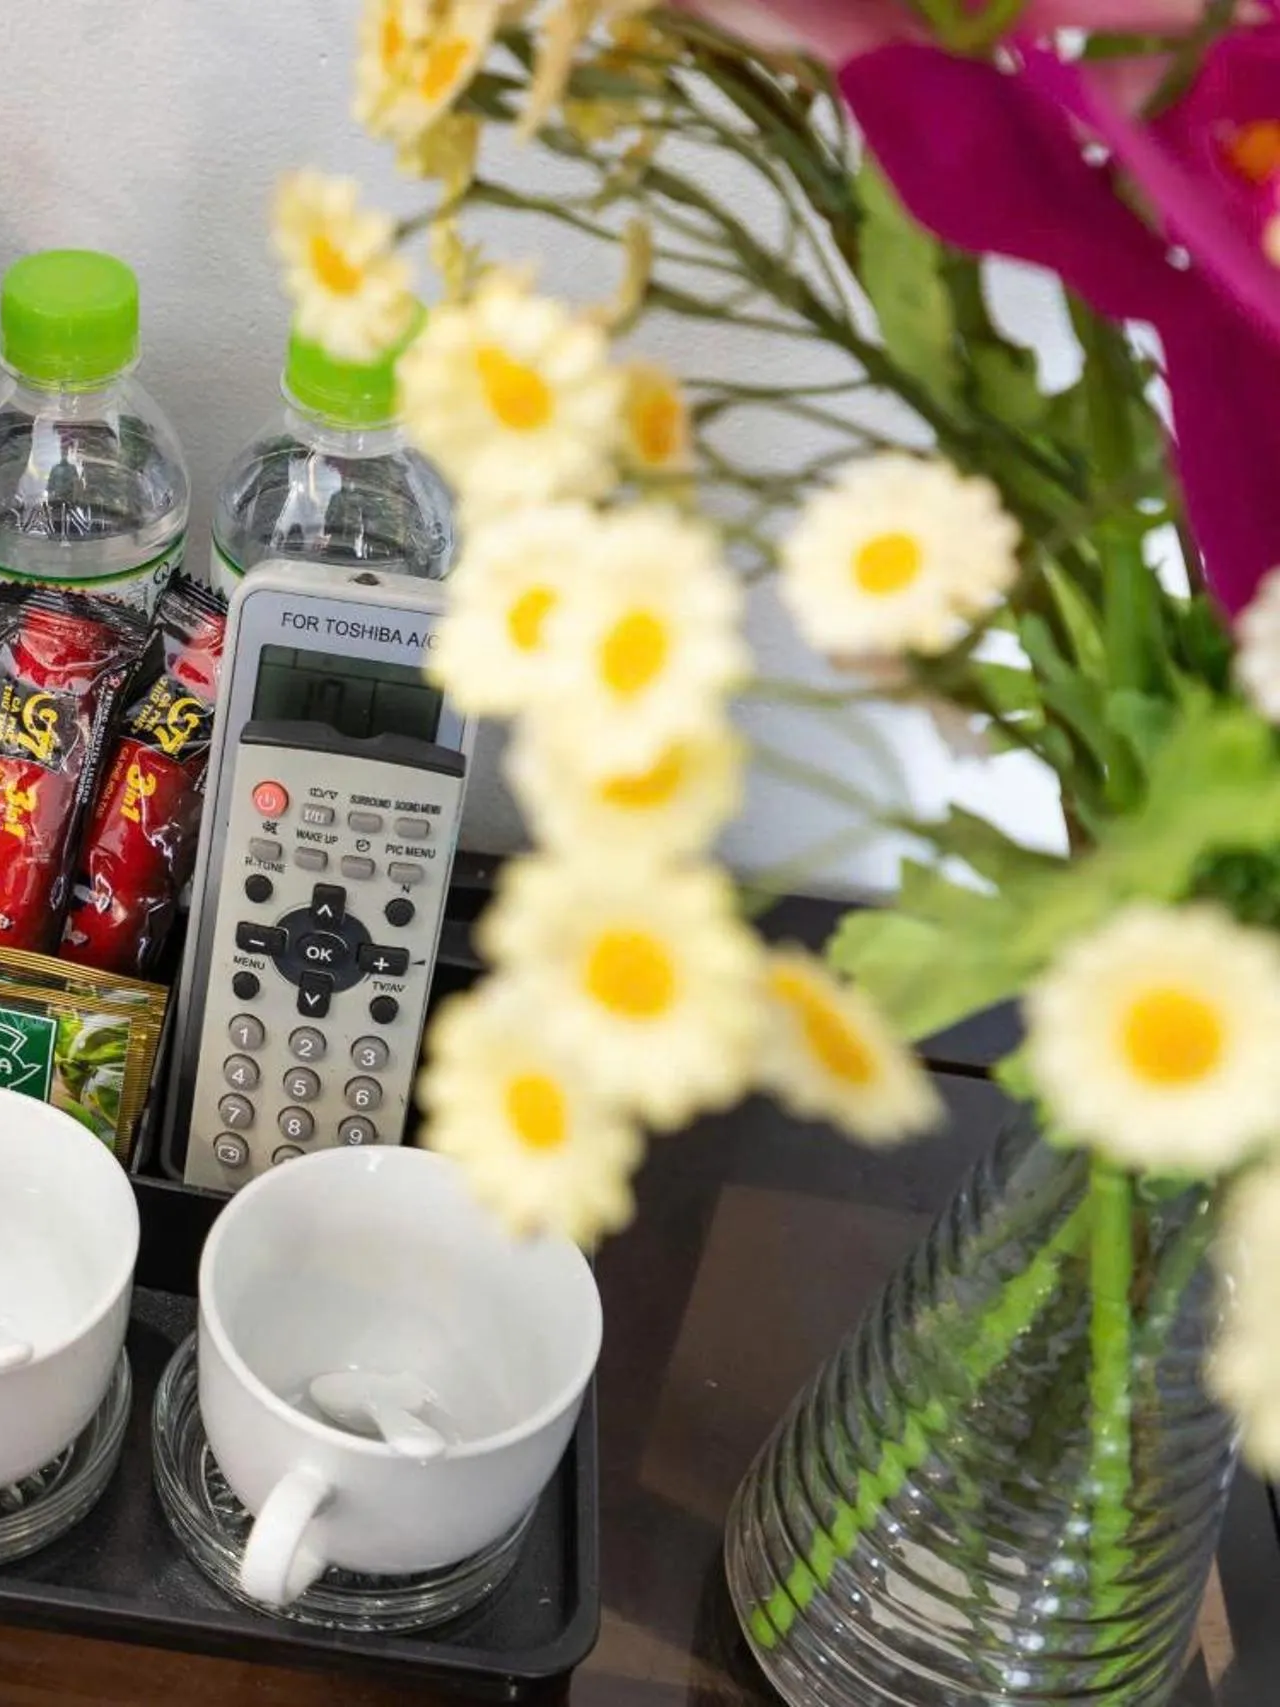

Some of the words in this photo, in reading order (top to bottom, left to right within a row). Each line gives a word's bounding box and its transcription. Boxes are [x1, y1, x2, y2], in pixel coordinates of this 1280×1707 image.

[281, 611, 319, 632] FOR
[326, 618, 403, 645] TOSHIBA
[120, 763, 156, 823] 3in1
[296, 828, 322, 842] WAKE
[324, 835, 338, 845] UP
[385, 843, 403, 856] PIC
[405, 846, 436, 860] MENU
[232, 955, 266, 971] MENU
[306, 946, 333, 963] OK
[372, 980, 407, 994] TV/AV
[239, 1028, 249, 1045] 1
[300, 1039, 313, 1057] 2
[362, 1049, 377, 1067] 3
[232, 1068, 246, 1084] 4
[293, 1079, 306, 1097] 5
[355, 1090, 370, 1107] 6
[228, 1107, 241, 1124] 7
[287, 1118, 301, 1136] 8
[348, 1129, 363, 1145] 9
